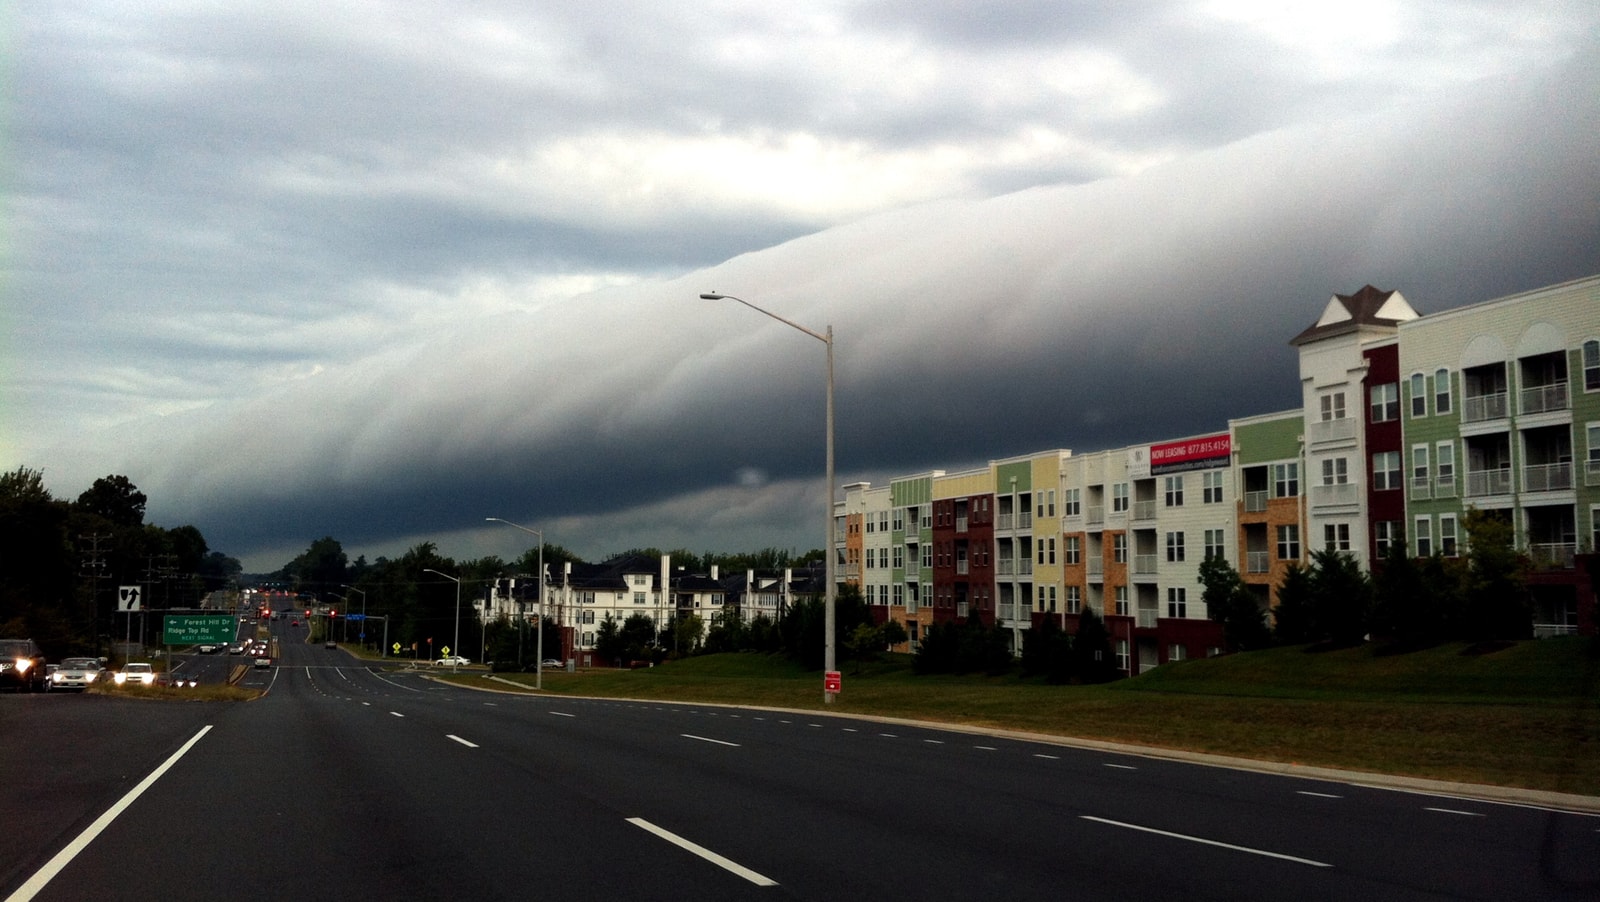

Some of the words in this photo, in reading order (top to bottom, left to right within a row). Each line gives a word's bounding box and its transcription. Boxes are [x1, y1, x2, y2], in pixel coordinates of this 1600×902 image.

[1152, 449, 1164, 459] NOW
[1165, 446, 1186, 458] LEASING
[1188, 440, 1229, 454] 877.815.4154
